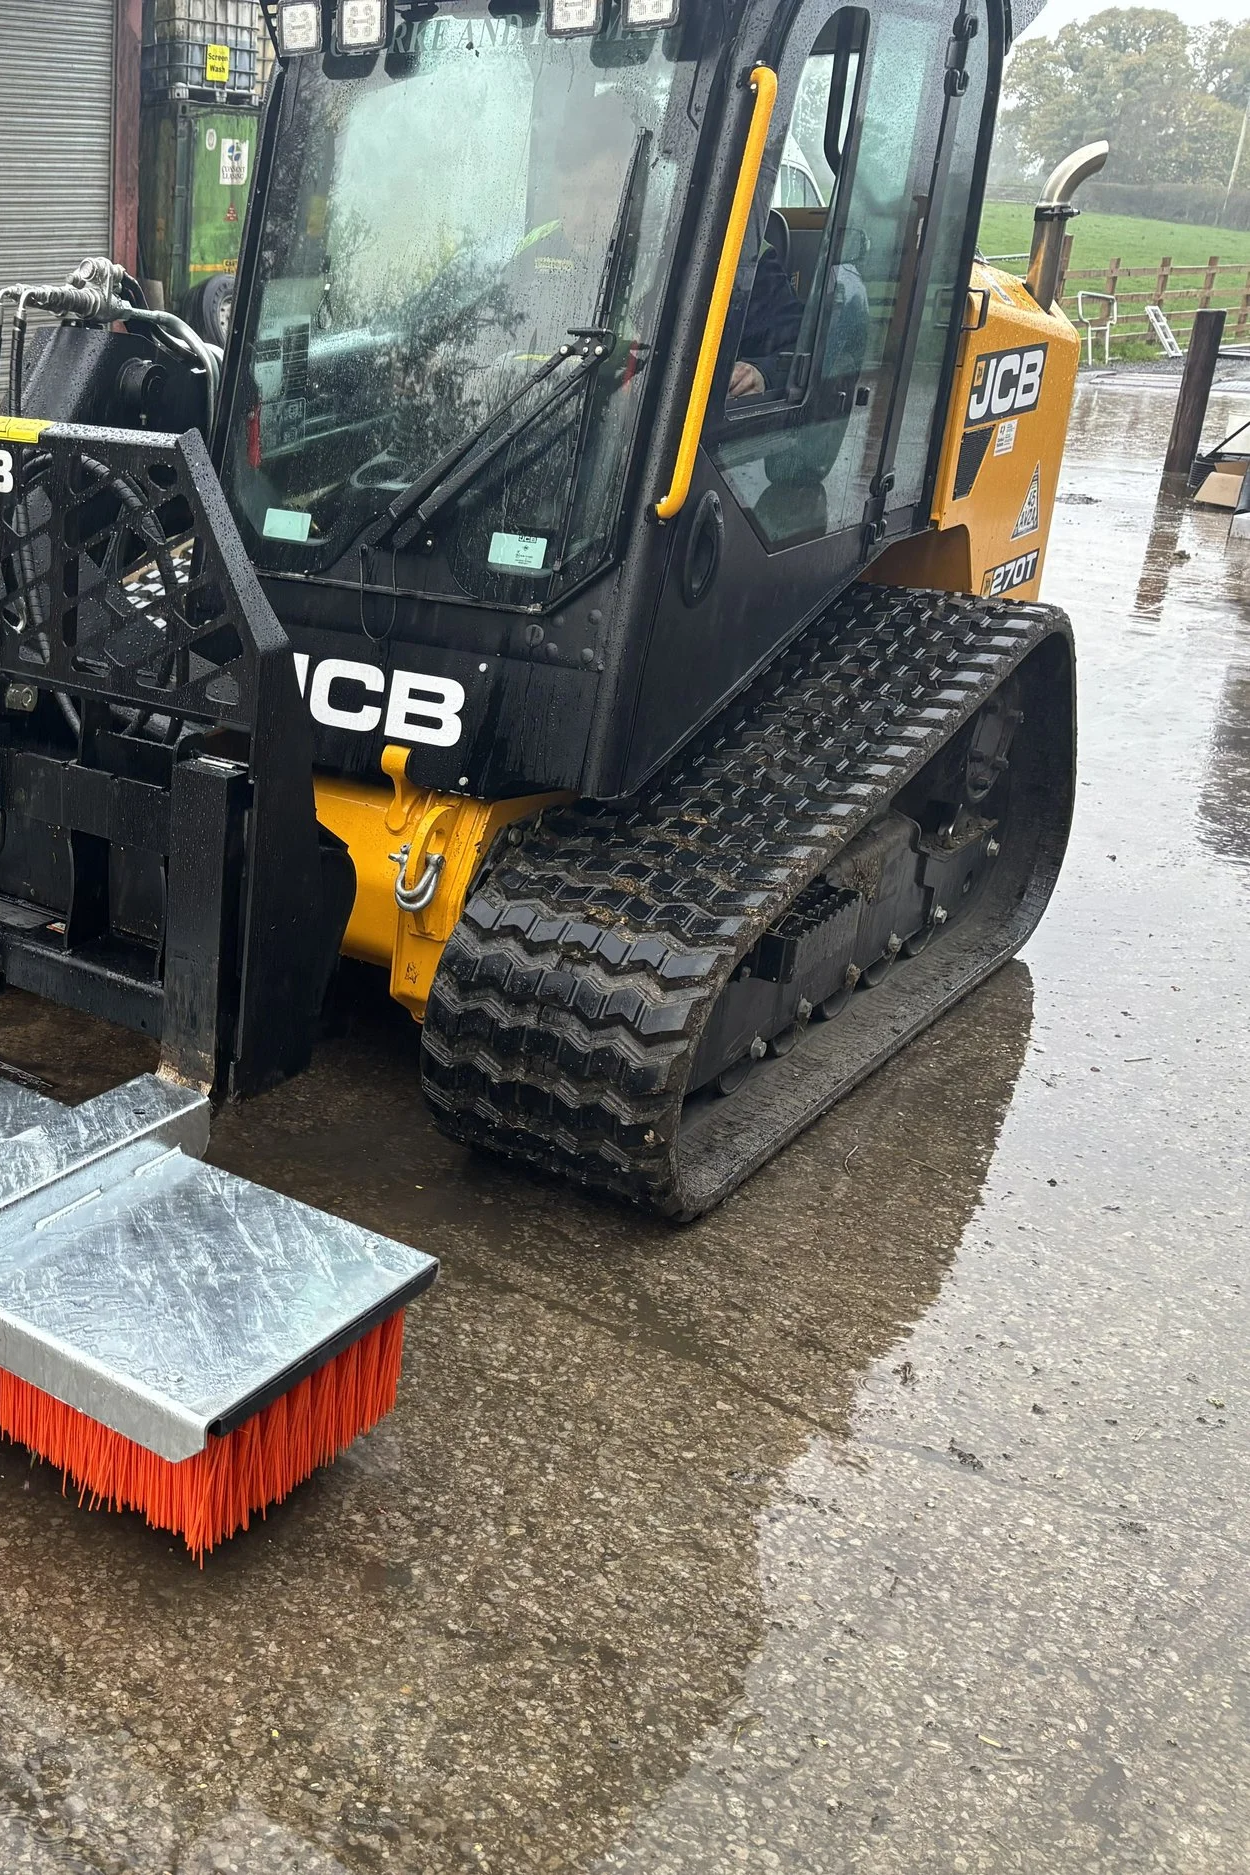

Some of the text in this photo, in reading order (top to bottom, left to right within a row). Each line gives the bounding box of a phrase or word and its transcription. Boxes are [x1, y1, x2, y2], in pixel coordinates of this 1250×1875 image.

[456, 14, 523, 49] AND
[207, 52, 228, 61] Screen
[210, 64, 226, 73] Wash
[969, 349, 1045, 420] JCB
[990, 551, 1038, 597] 270T
